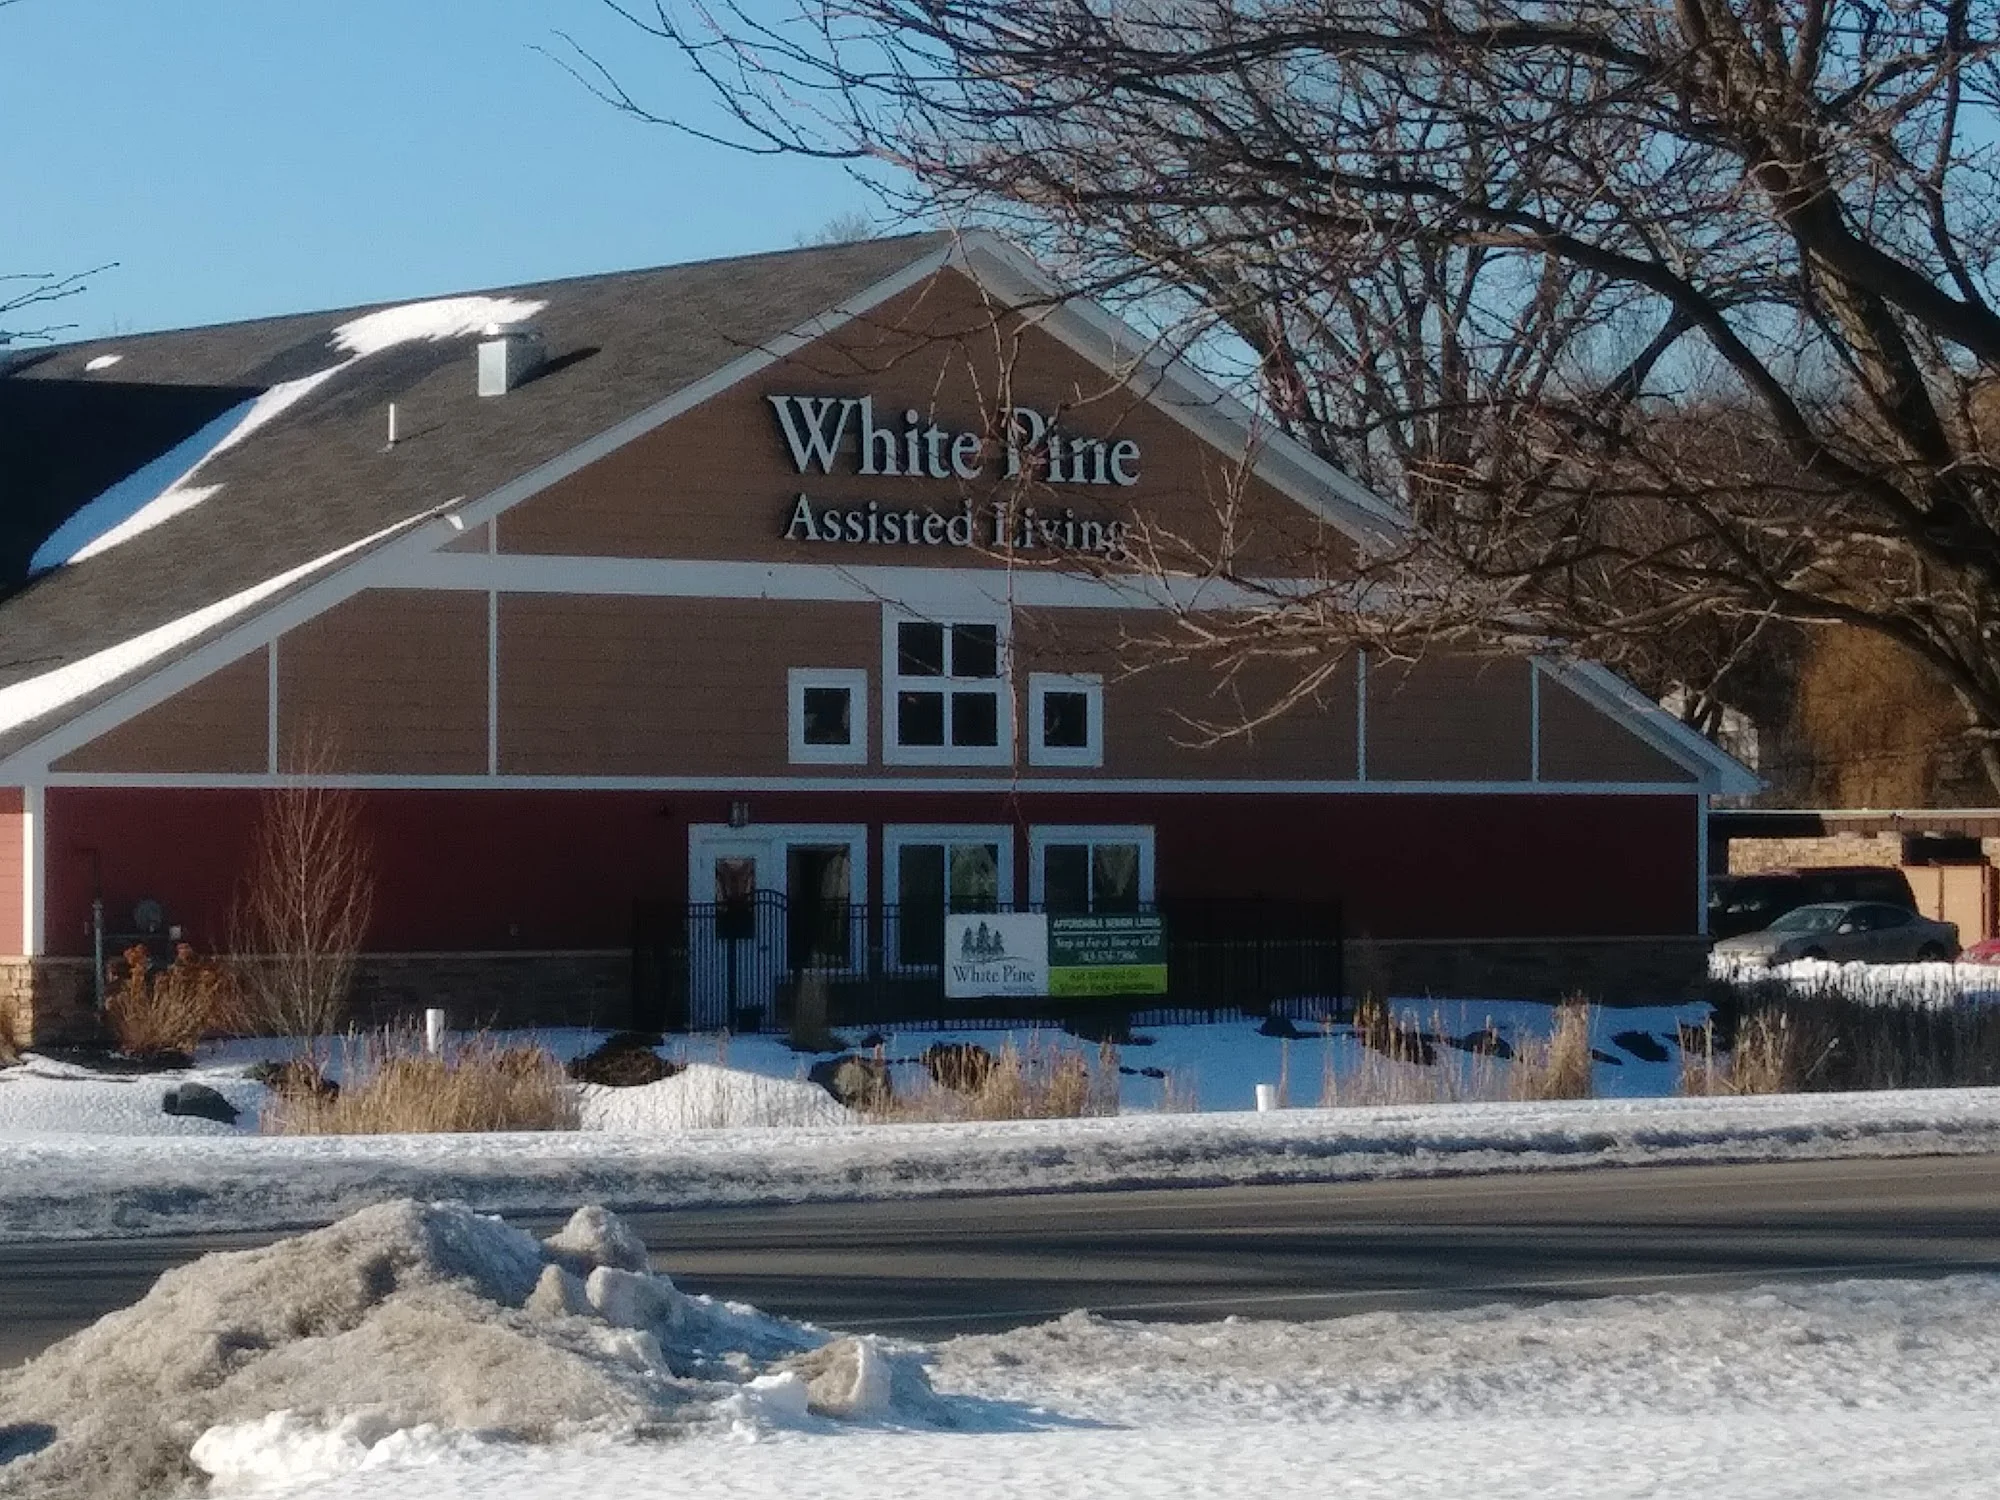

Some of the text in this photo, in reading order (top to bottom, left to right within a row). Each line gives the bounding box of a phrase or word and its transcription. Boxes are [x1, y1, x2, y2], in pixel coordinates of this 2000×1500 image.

[767, 395, 1141, 486] White Pine
[784, 492, 1131, 564] Assisted Living
[952, 964, 1036, 982] White Pine
